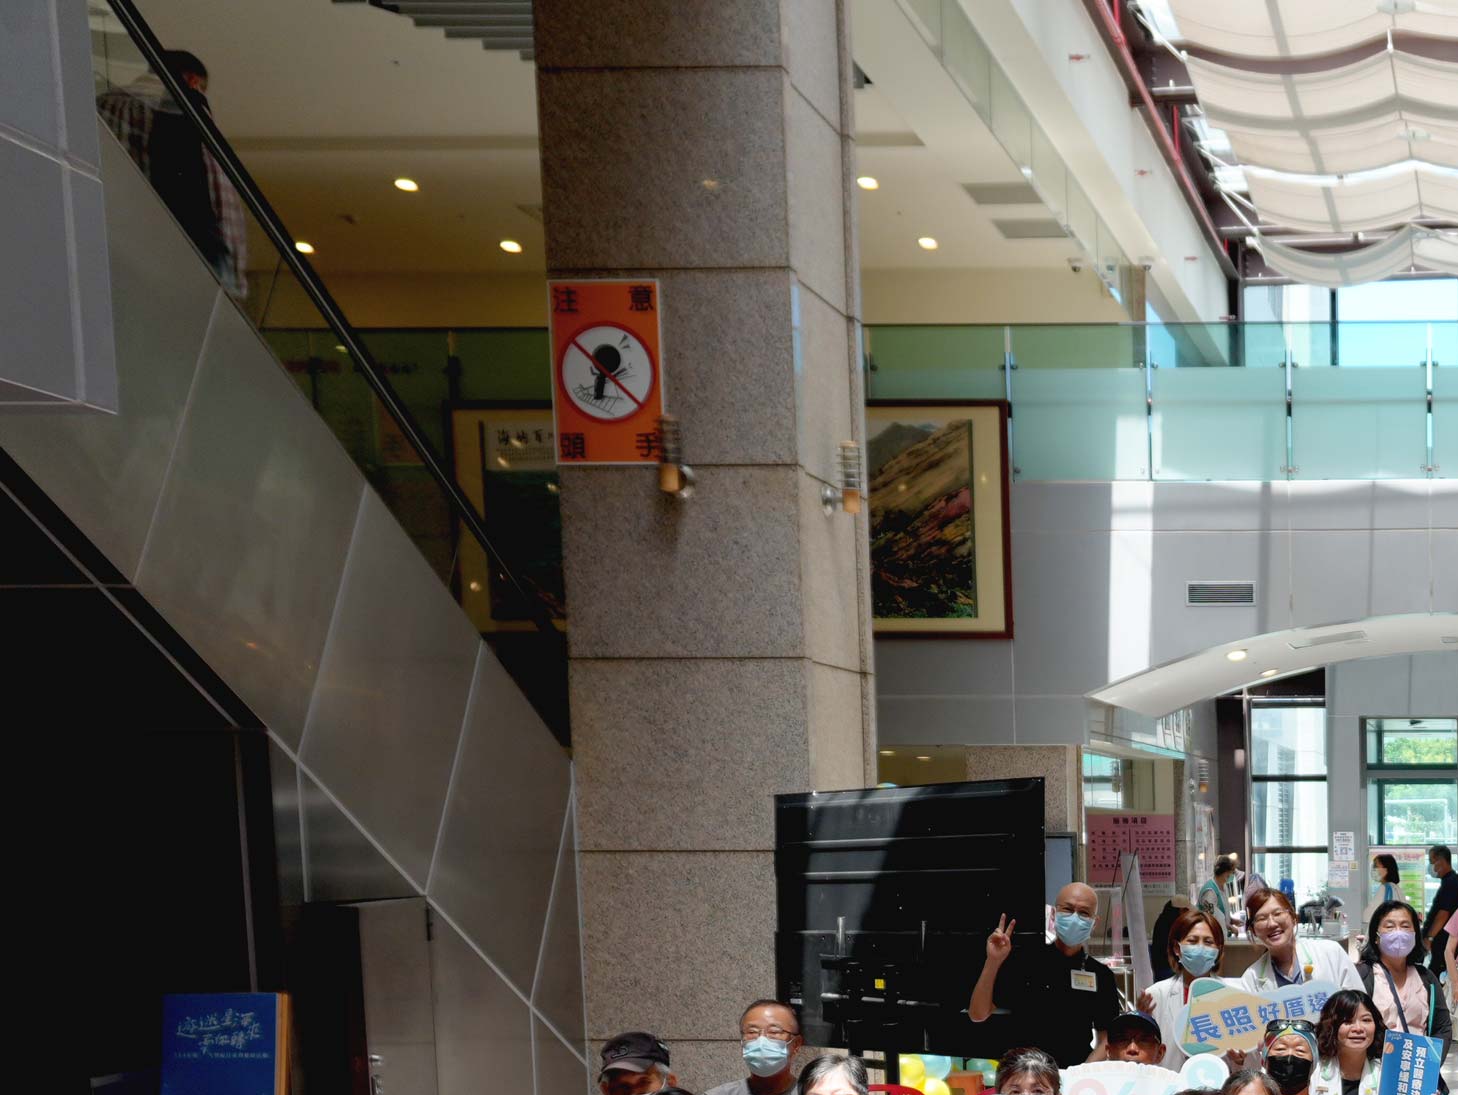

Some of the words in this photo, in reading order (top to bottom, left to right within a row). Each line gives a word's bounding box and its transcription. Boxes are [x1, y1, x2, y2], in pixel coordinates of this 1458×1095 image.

[1190, 991, 1329, 1043] 長照好厝邊
